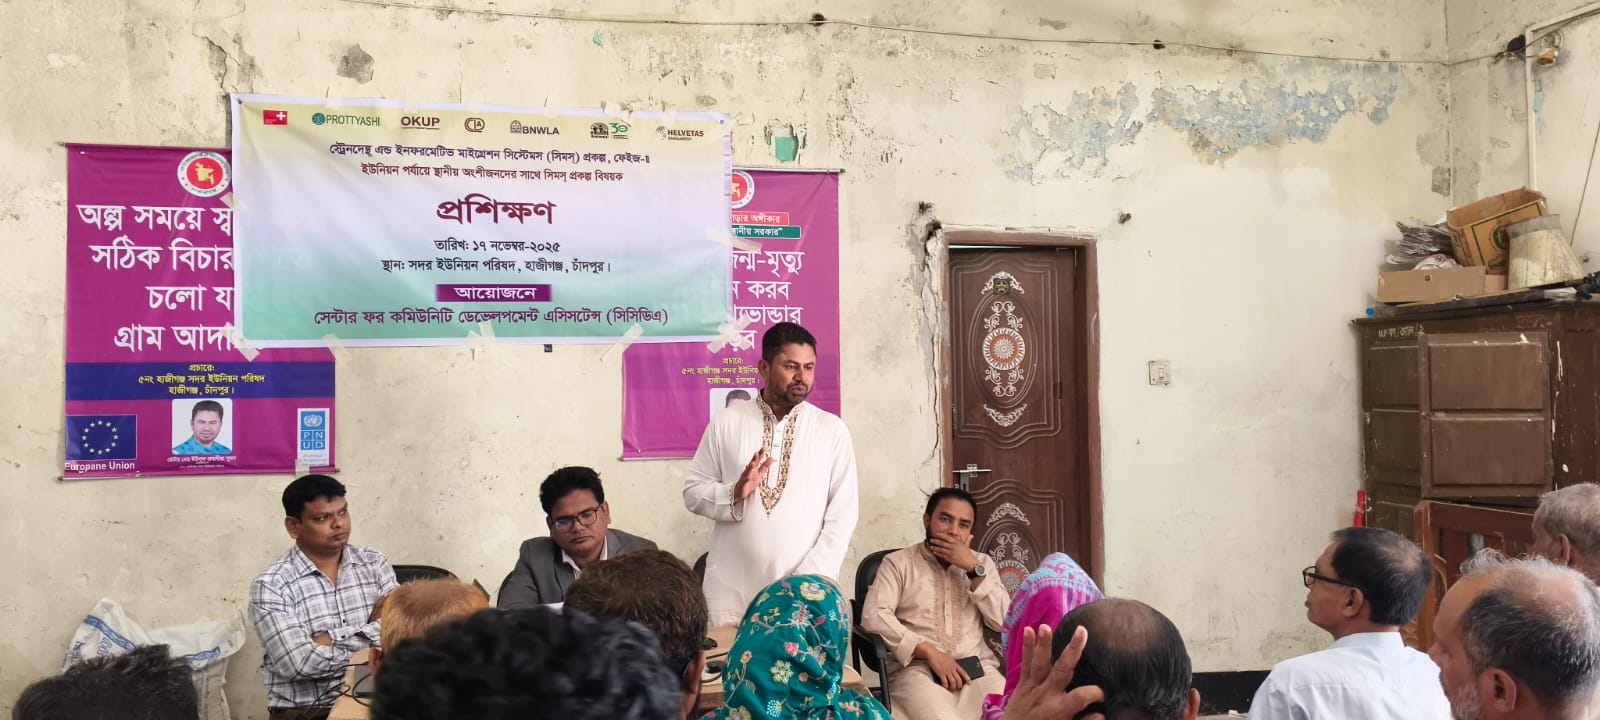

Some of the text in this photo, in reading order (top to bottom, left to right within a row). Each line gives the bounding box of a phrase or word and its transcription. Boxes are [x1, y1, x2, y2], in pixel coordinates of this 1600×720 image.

[326, 115, 380, 126] PROTTYASHI
[401, 116, 440, 127] OKUP
[522, 126, 560, 135] BNWLA
[668, 129, 704, 137] HELVETAS
[396, 144, 455, 157] ইনফরমেটিভ
[458, 147, 500, 159] মাইগ্রেশন
[504, 147, 543, 160] সিস্টেমস
[361, 162, 399, 175] ইউনিয়ন
[403, 163, 430, 176] পর্যায়ে
[434, 165, 459, 178] স্থানীয়
[463, 166, 516, 179] অংশীজনদের
[520, 170, 540, 181] সাথে
[570, 171, 592, 182] প্রকল্প
[595, 170, 624, 182] বিষয়ক
[437, 193, 557, 224] প্রশিক্ষণ
[76, 204, 127, 231] অল্প
[130, 205, 206, 232] সময়ে
[88, 234, 163, 271] সঠিক
[473, 241, 486, 251] ১৭
[490, 240, 560, 252] নভেম্বর-২০২৫
[409, 260, 432, 271] সদর
[436, 257, 478, 271] ইউনিয়ন
[145, 284, 207, 311] চলো
[454, 286, 537, 300] আয়োজনে
[745, 281, 792, 300] করব
[314, 307, 669, 326] সেন্টার ফর কমিউনিটি ডেভেলপমেন্ট এসিসটেন্স (সিসিডিএ)
[114, 323, 166, 352] গ্রাম
[188, 375, 205, 384] সদর
[208, 373, 238, 384] ইউনিয়ন
[241, 372, 265, 383] পরিষদ
[64, 461, 135, 472] Europane Union
